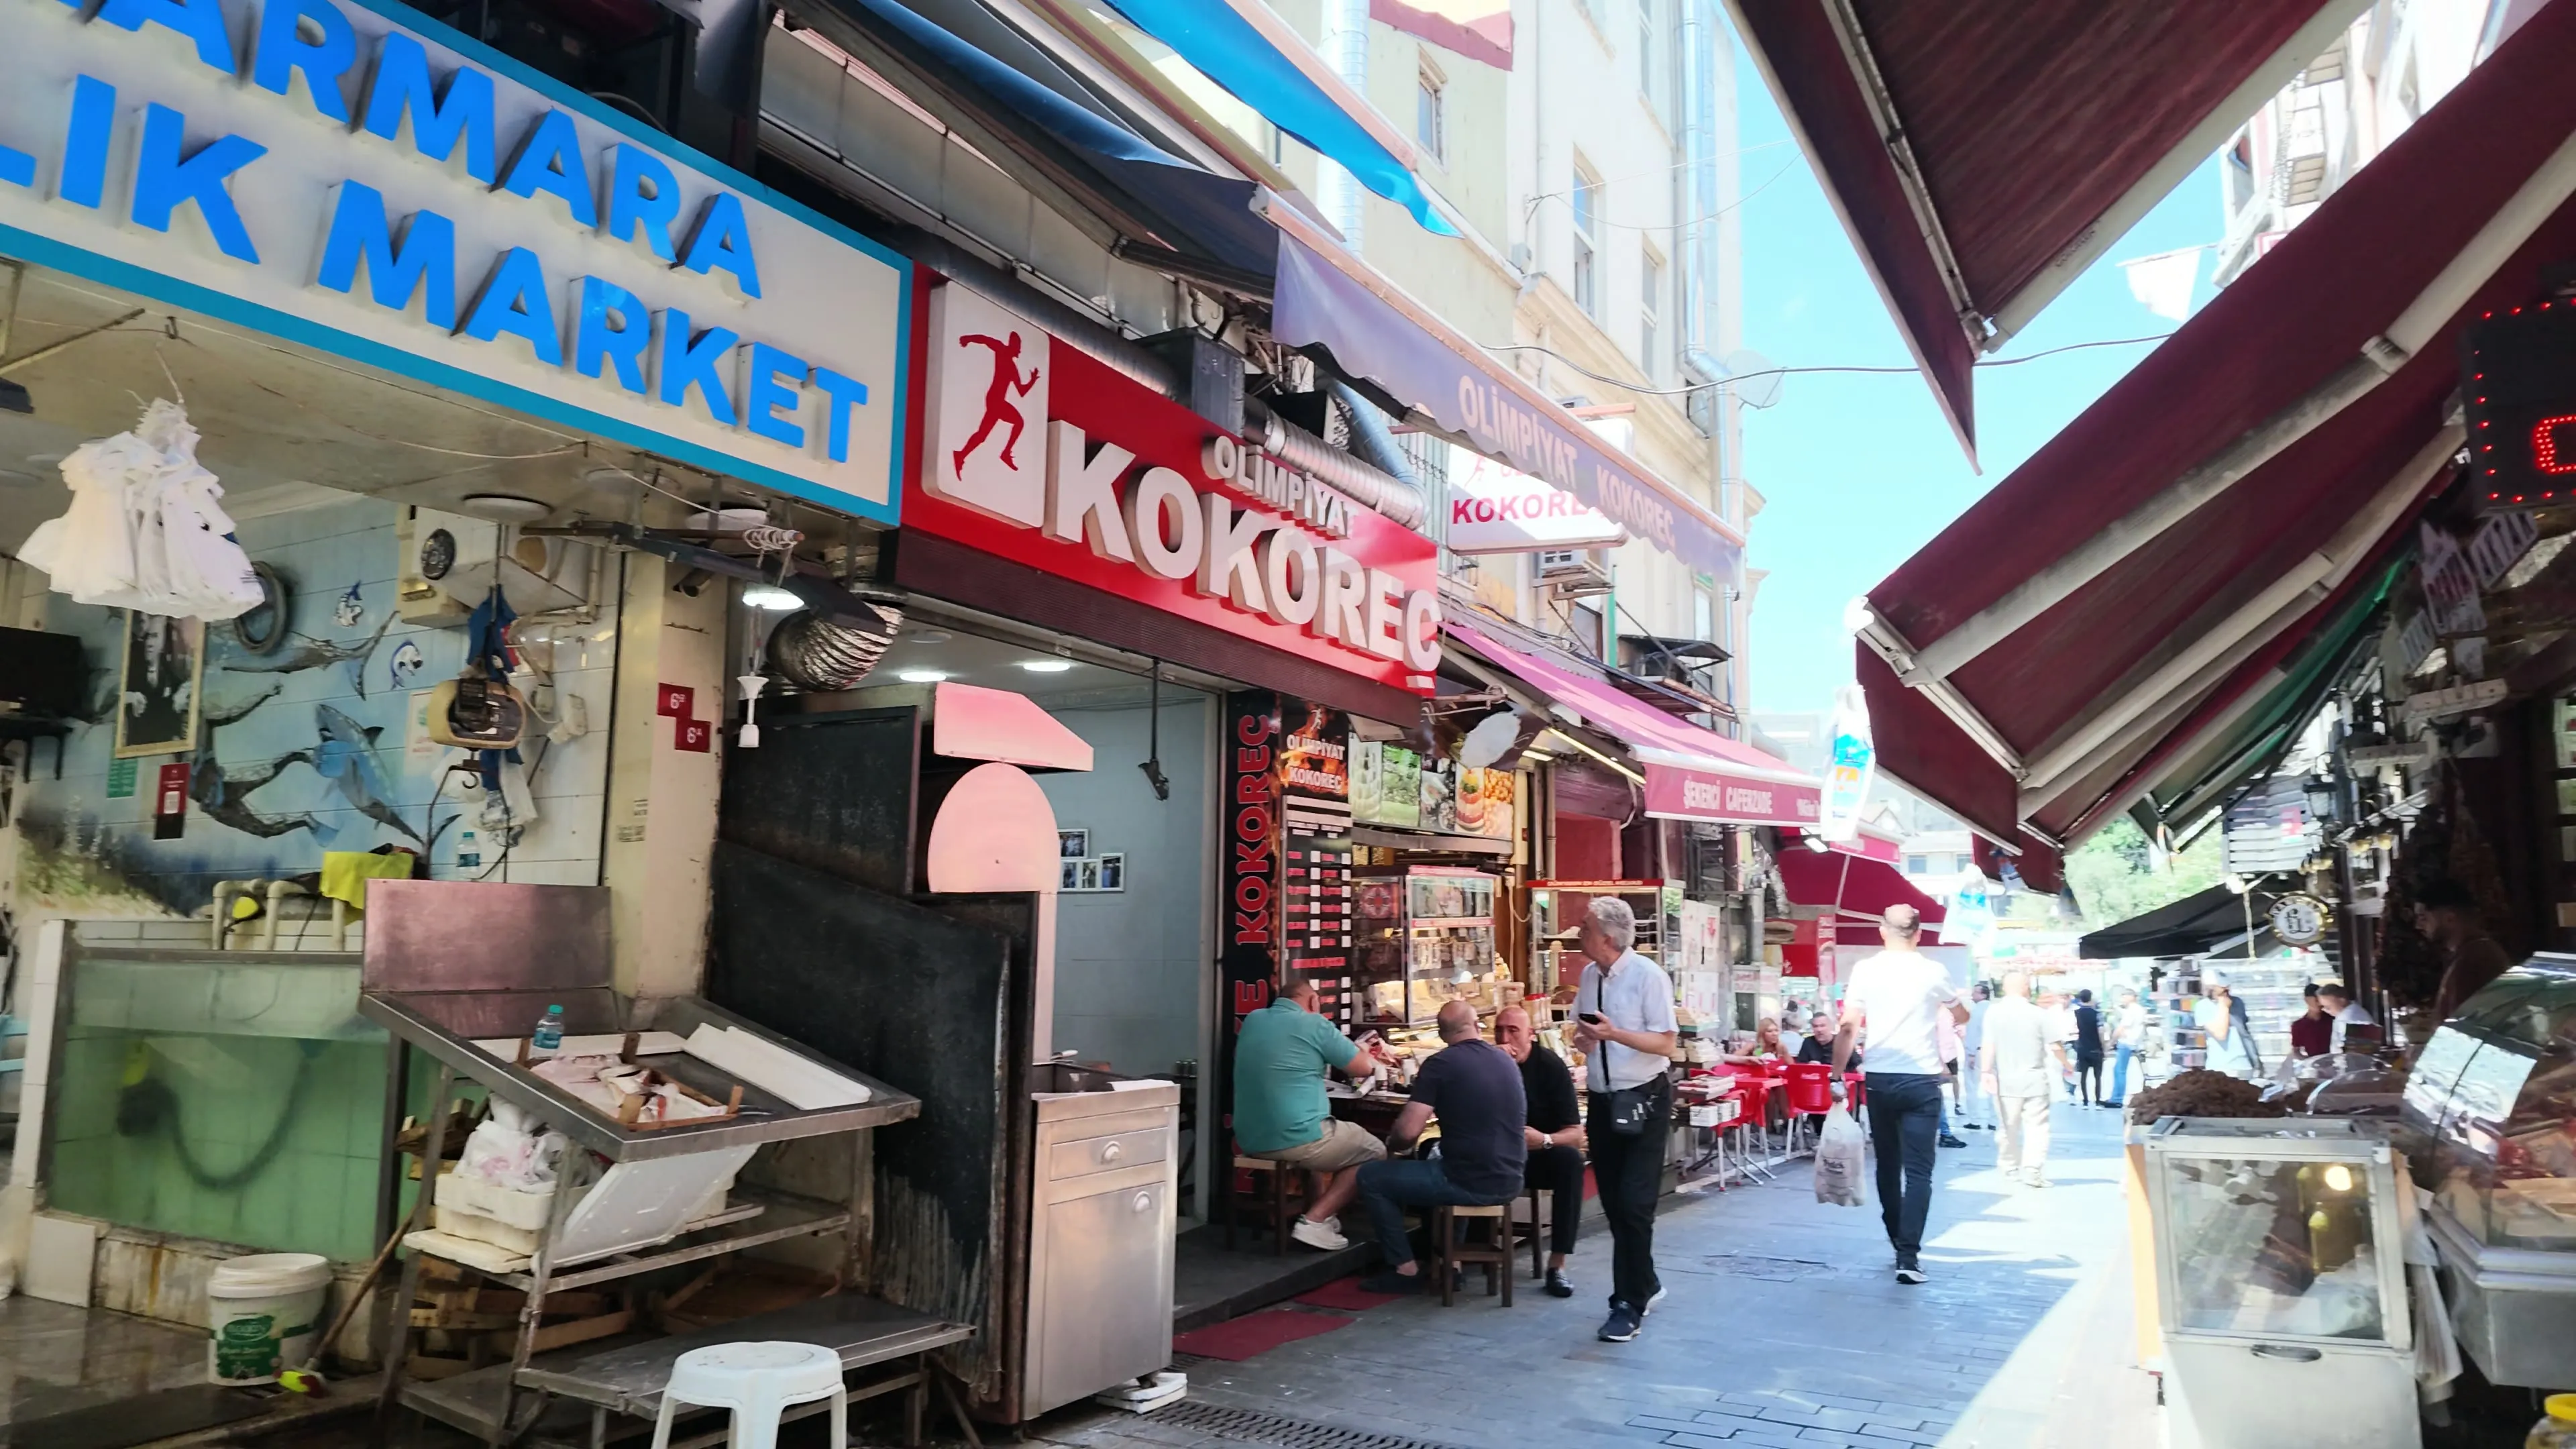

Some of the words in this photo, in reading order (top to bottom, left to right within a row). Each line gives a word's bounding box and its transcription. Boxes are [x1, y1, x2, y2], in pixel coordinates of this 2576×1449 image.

[57, 0, 762, 299] ARMARA
[317, 178, 868, 464] MARKET
[1210, 435, 1359, 539] OLİMPİYAT
[1458, 375, 1578, 490] OLİMPİYAT
[1236, 714, 1279, 945] KOKOREÇ
[1287, 734, 1346, 761] OLİMPİYAT
